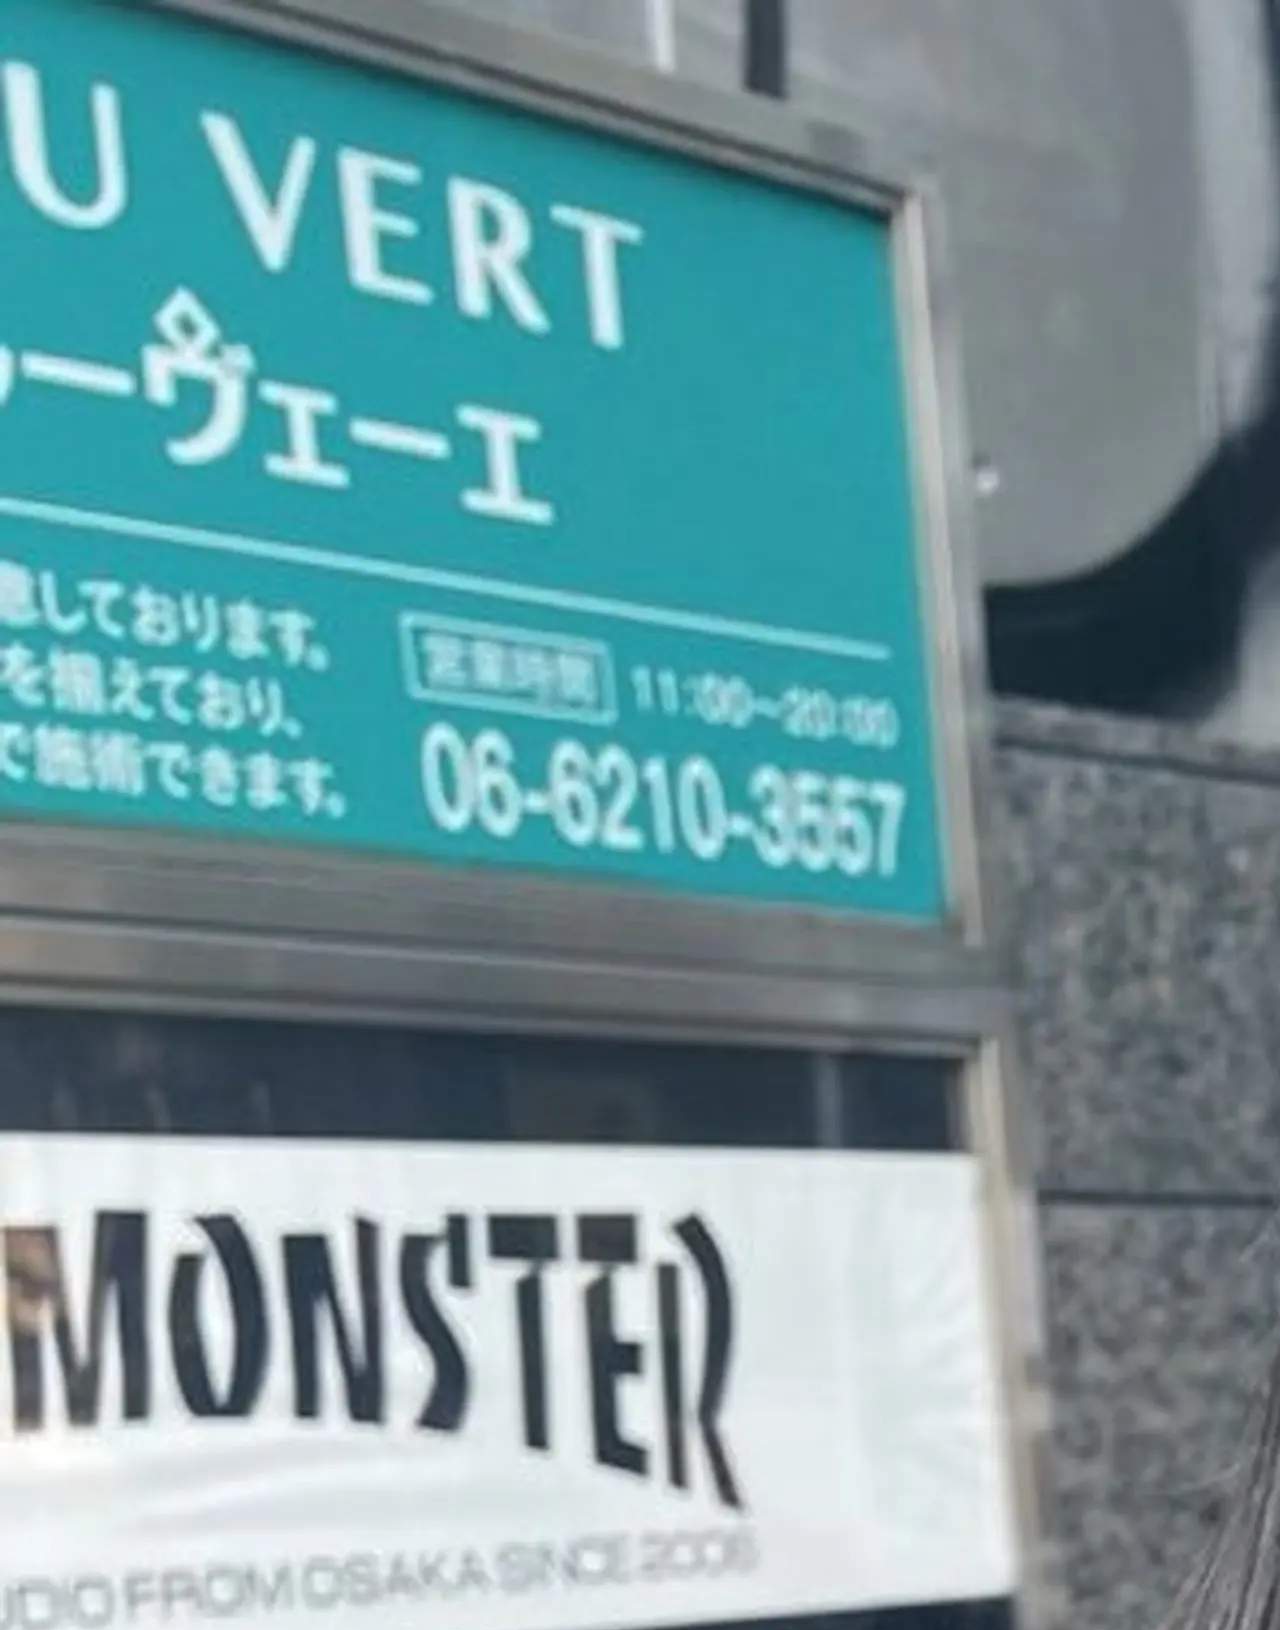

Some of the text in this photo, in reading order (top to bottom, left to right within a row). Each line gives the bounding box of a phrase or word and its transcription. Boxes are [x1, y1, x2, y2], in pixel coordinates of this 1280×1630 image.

[3, 60, 644, 349] U VERT
[420, 721, 906, 880] 06-6210-3557
[2, 1208, 746, 1512] MONSTER
[122, 1558, 295, 1625] FROM
[301, 1544, 494, 1611] OSAKA
